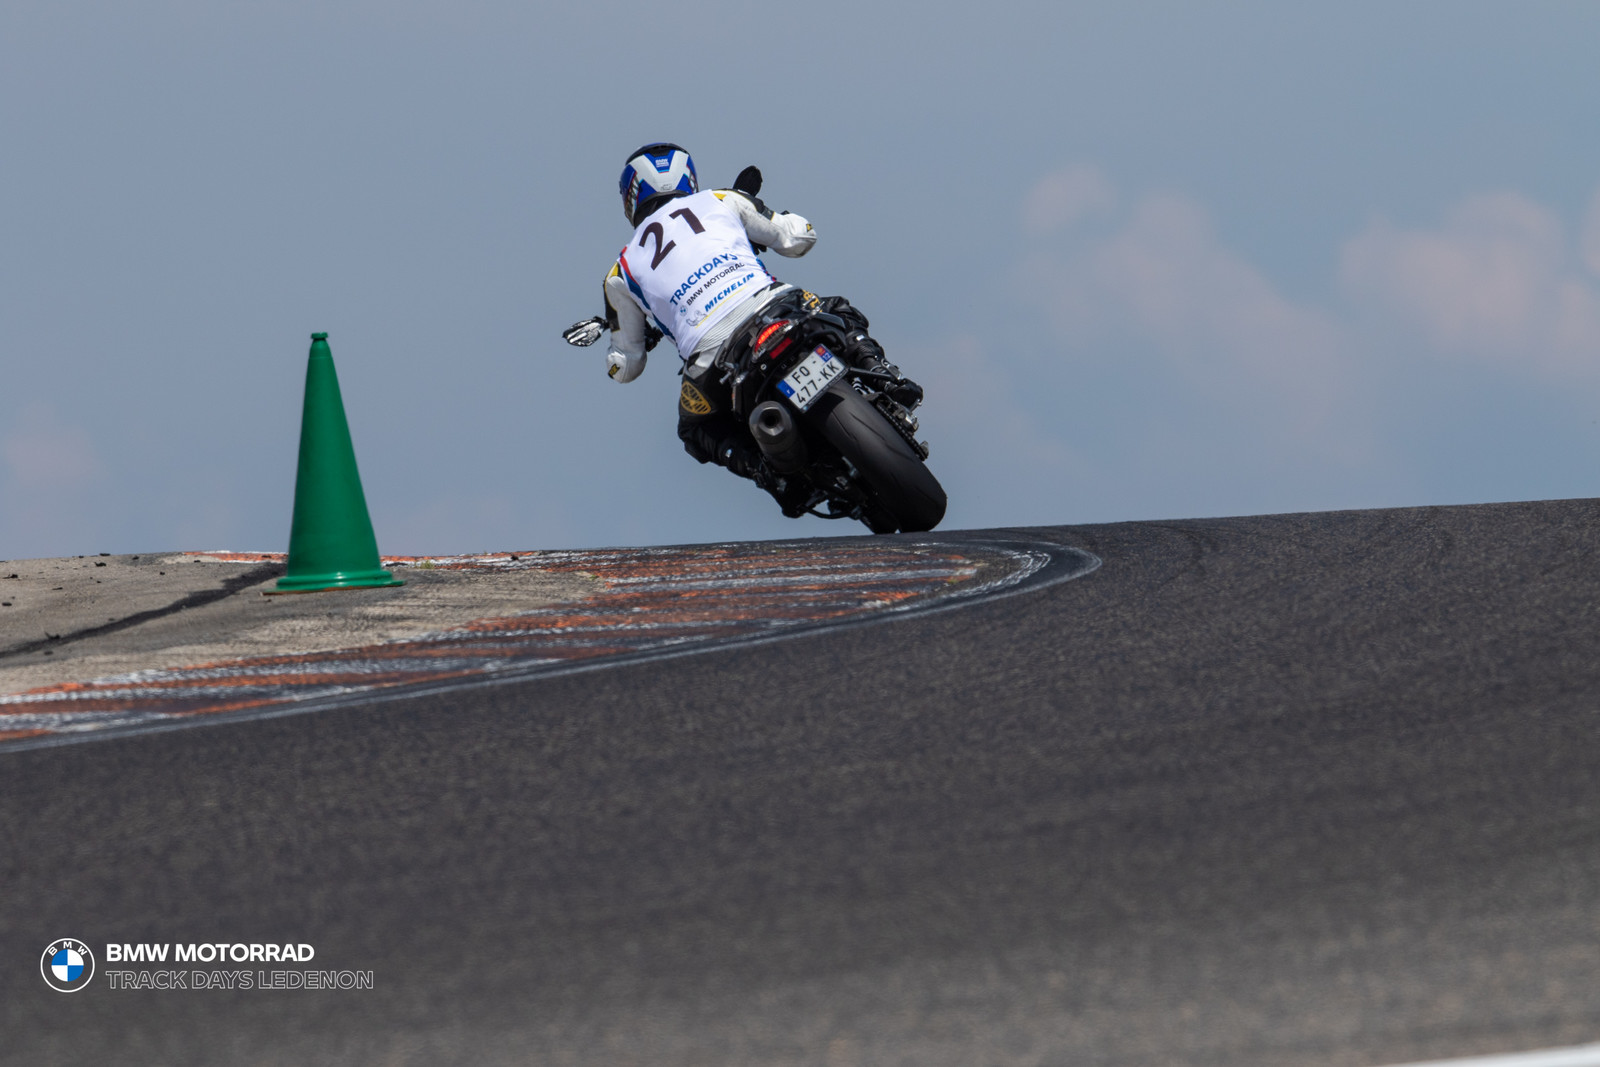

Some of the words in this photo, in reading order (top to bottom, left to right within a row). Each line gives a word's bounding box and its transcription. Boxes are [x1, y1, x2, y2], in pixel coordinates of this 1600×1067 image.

[639, 207, 706, 271] 21
[669, 253, 738, 306] TRACKDAYS
[686, 287, 704, 306] BMW
[705, 272, 755, 312] MICHELIN
[822, 351, 832, 361] 12
[796, 360, 840, 404] 477-KK
